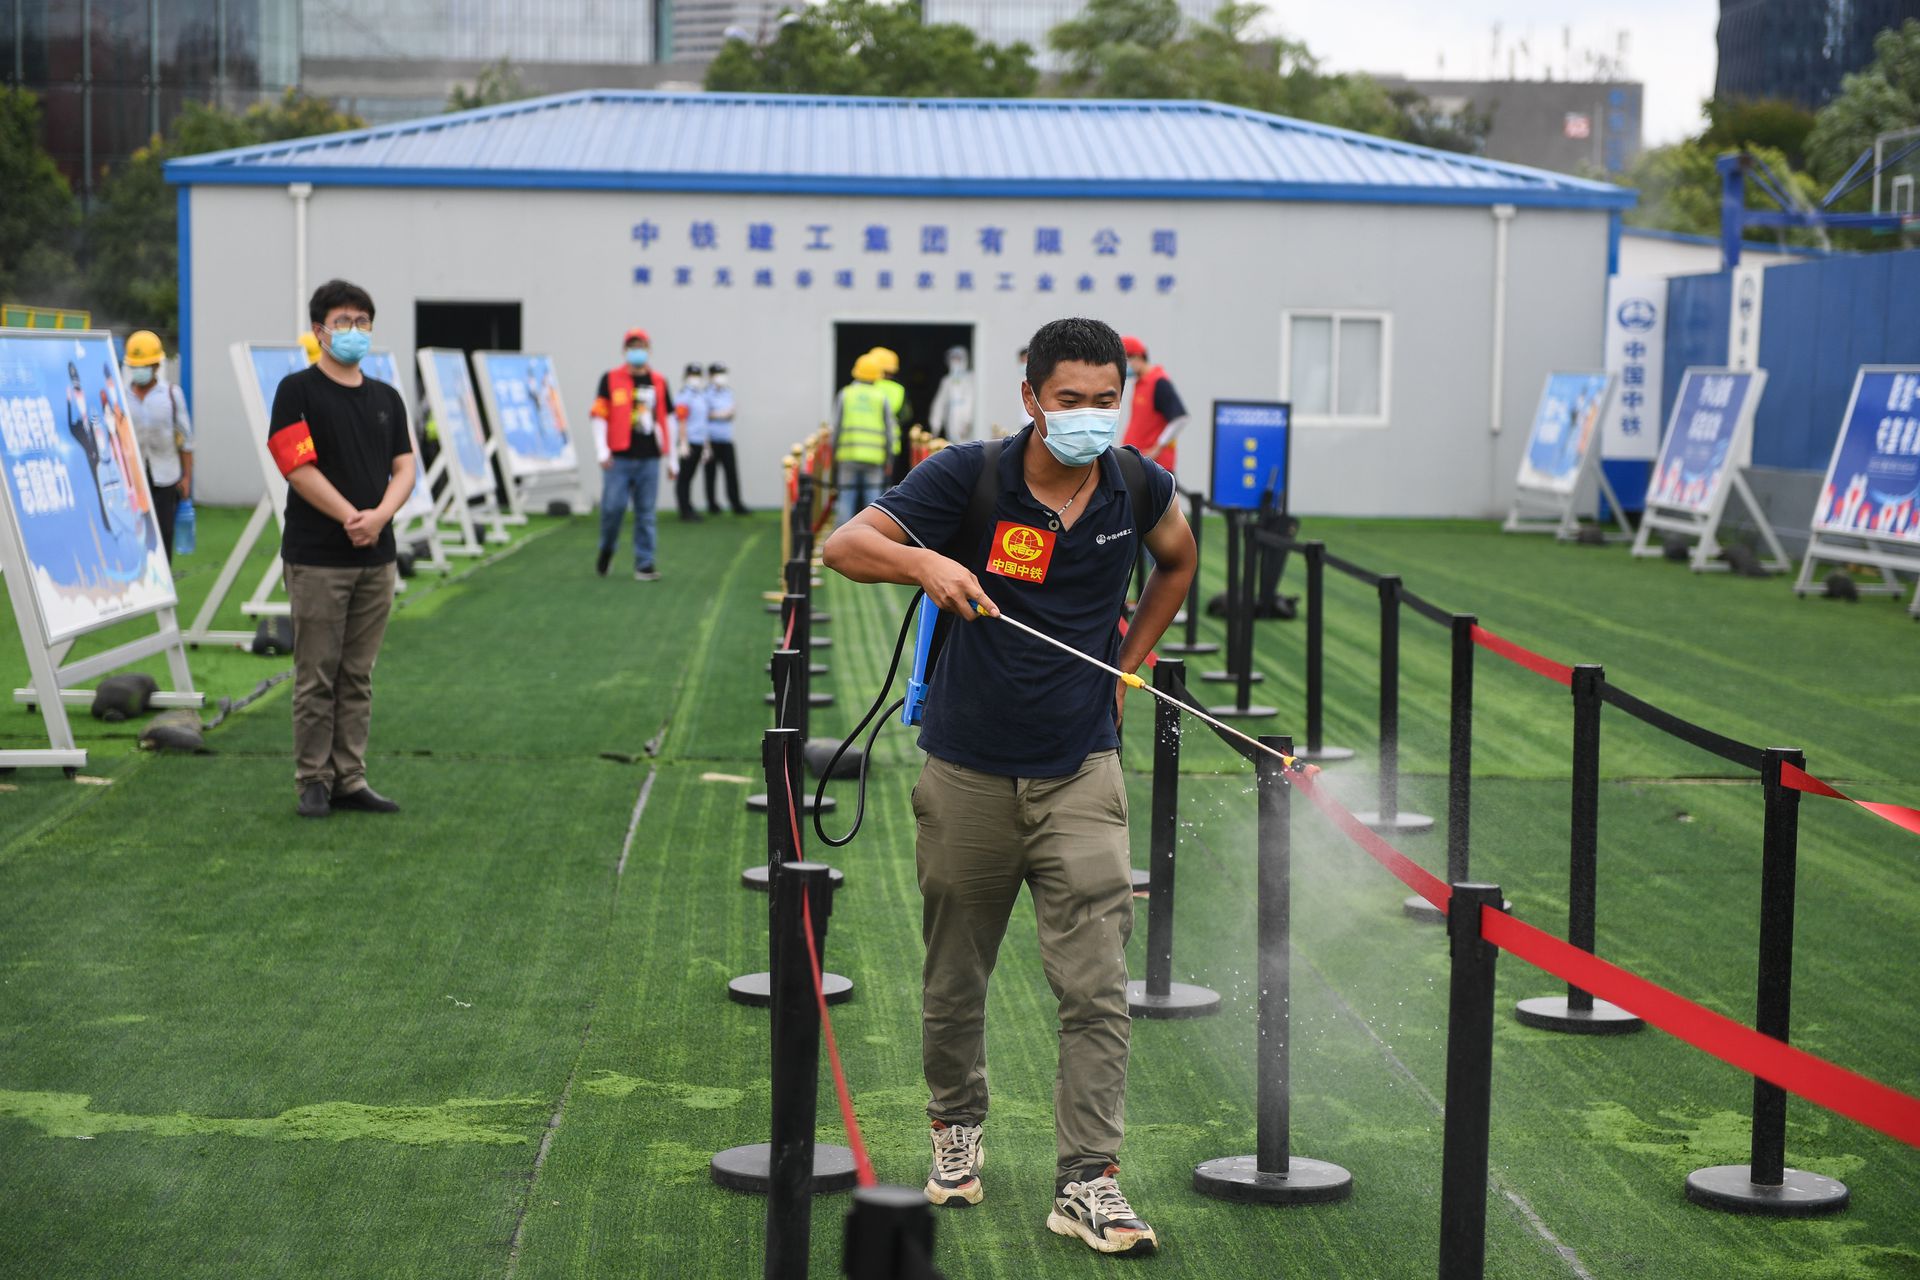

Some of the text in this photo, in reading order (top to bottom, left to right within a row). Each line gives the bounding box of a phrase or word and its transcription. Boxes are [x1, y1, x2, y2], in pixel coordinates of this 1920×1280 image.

[631, 220, 1178, 257] 中铁建工集团有限公司
[1620, 339, 1646, 436] 中国中铁
[992, 558, 1043, 580] 中国中铁
